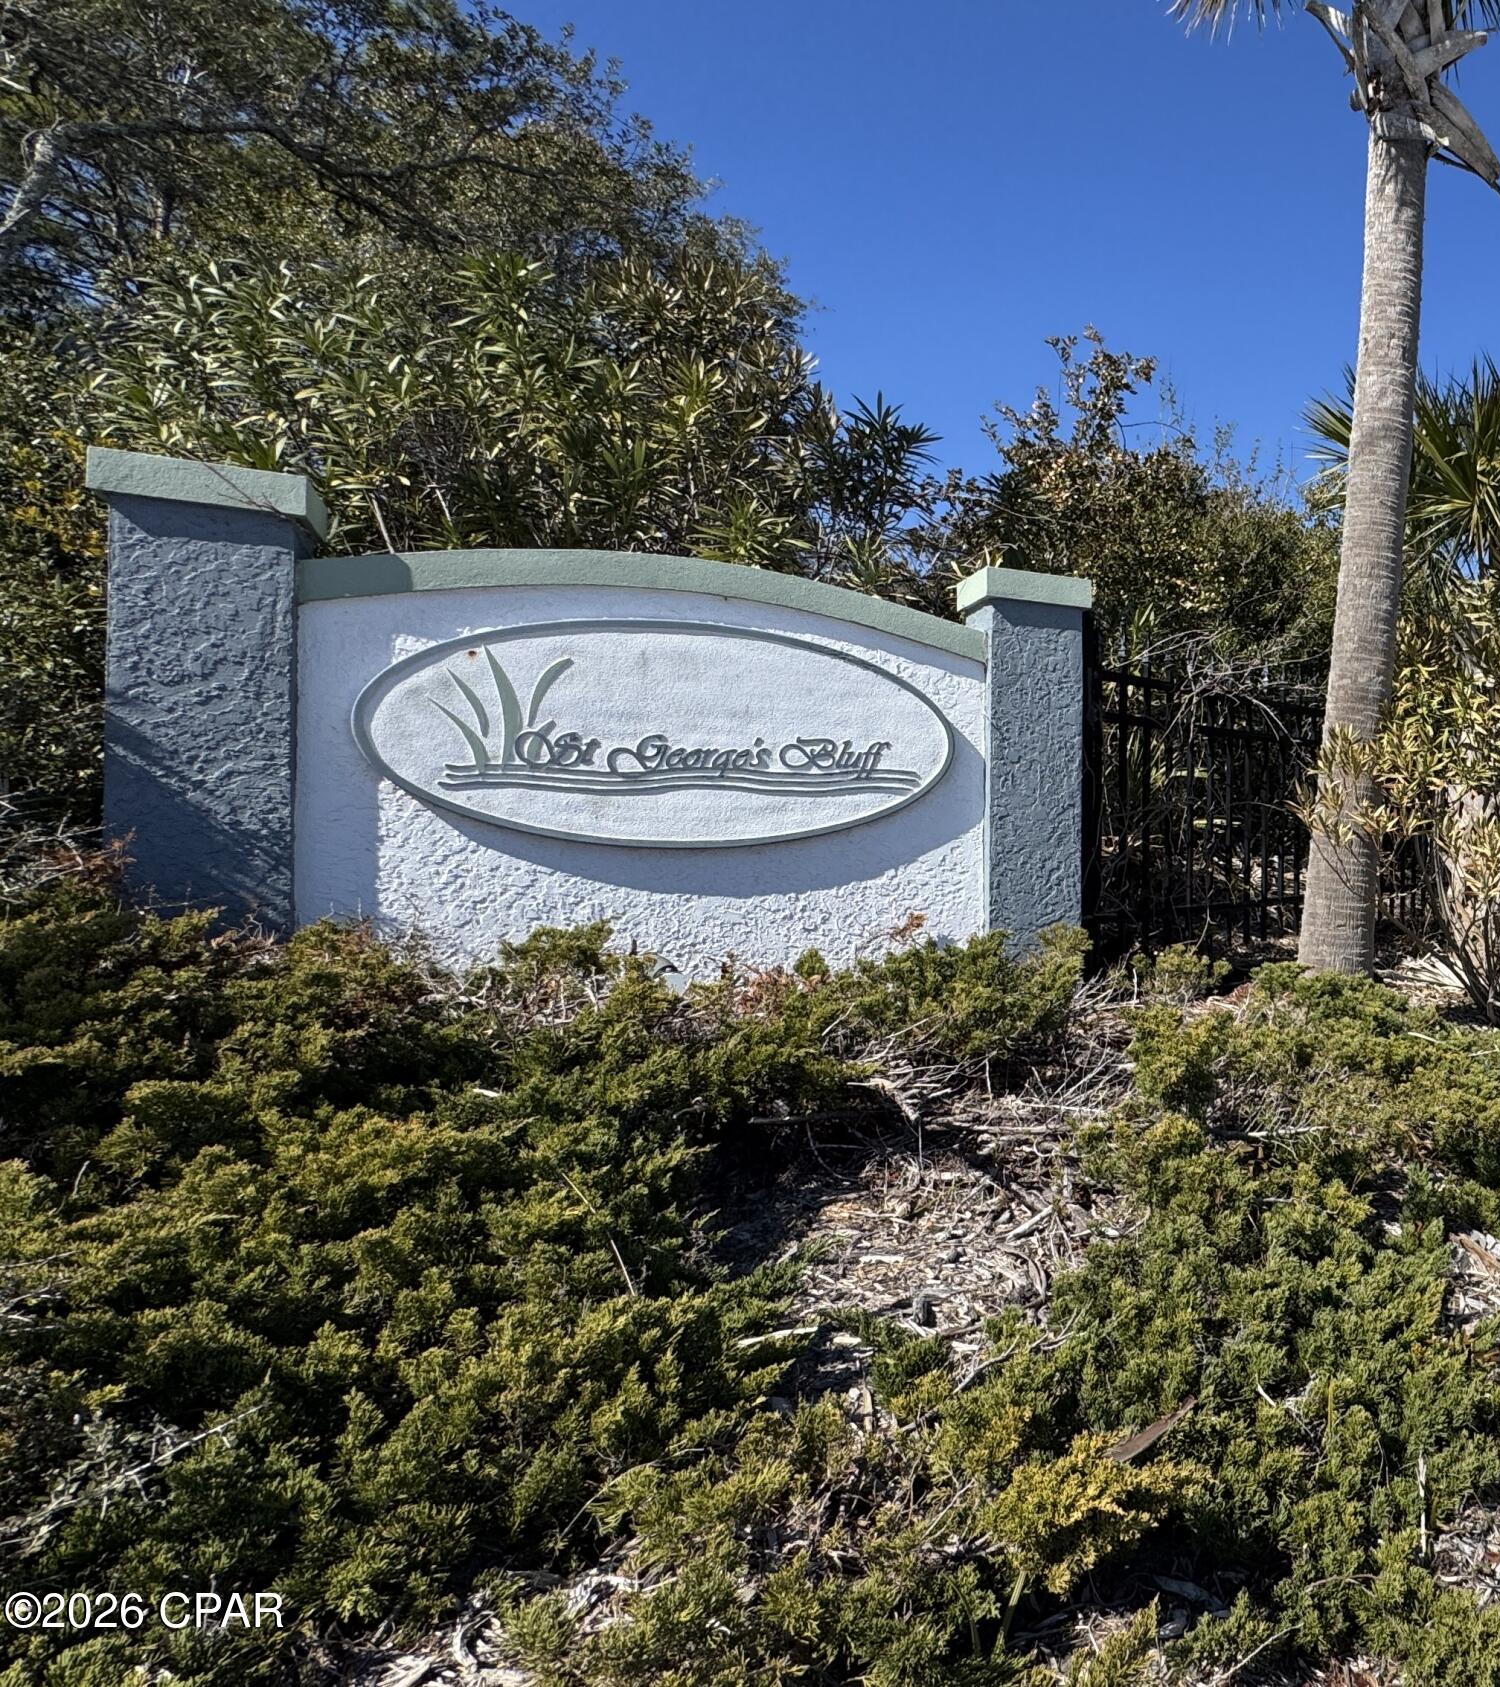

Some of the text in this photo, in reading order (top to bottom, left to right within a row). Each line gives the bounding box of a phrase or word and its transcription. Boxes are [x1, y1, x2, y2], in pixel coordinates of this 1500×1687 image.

[514, 731, 893, 780] St George's Bluff
